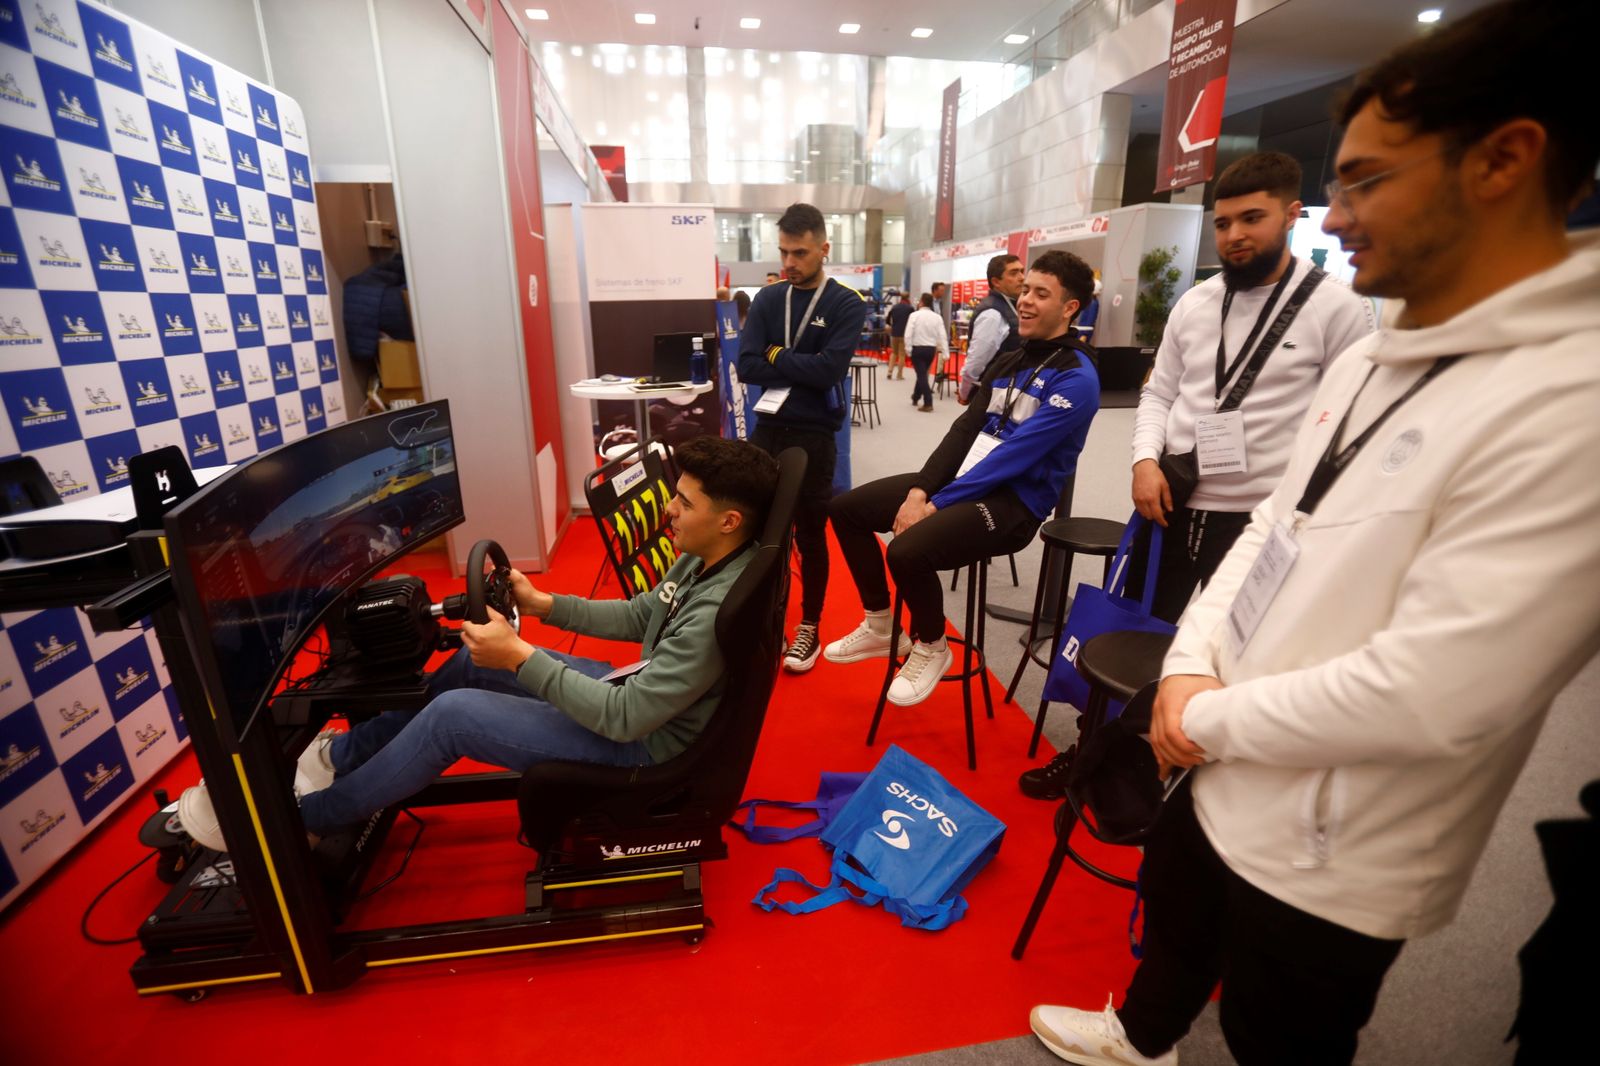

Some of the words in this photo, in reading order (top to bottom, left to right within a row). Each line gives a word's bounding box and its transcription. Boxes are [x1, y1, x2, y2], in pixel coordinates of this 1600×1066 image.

[1172, 34, 1198, 53] EQUIPO
[1199, 20, 1224, 40] TALLER
[1174, 17, 1205, 40] MUESTRA
[1176, 40, 1212, 64] RECAMBIO
[1169, 68, 1179, 79] DE
[671, 215, 706, 225] SKF
[1271, 302, 1299, 336] MAX
[1230, 368, 1256, 400] MAX
[22, 414, 67, 427] MICHELIN
[85, 404, 122, 416] MICHELIN
[105, 472, 129, 485] MICHE
[60, 485, 89, 498] CHELIN
[357, 599, 394, 611] FANATEC
[33, 645, 78, 673] MICHELIN
[60, 708, 100, 739] MICHELIN
[83, 766, 122, 801] MICHELIN
[886, 782, 958, 838] SACHS
[355, 808, 385, 852] FANATE
[626, 839, 702, 855] MICHELIN
